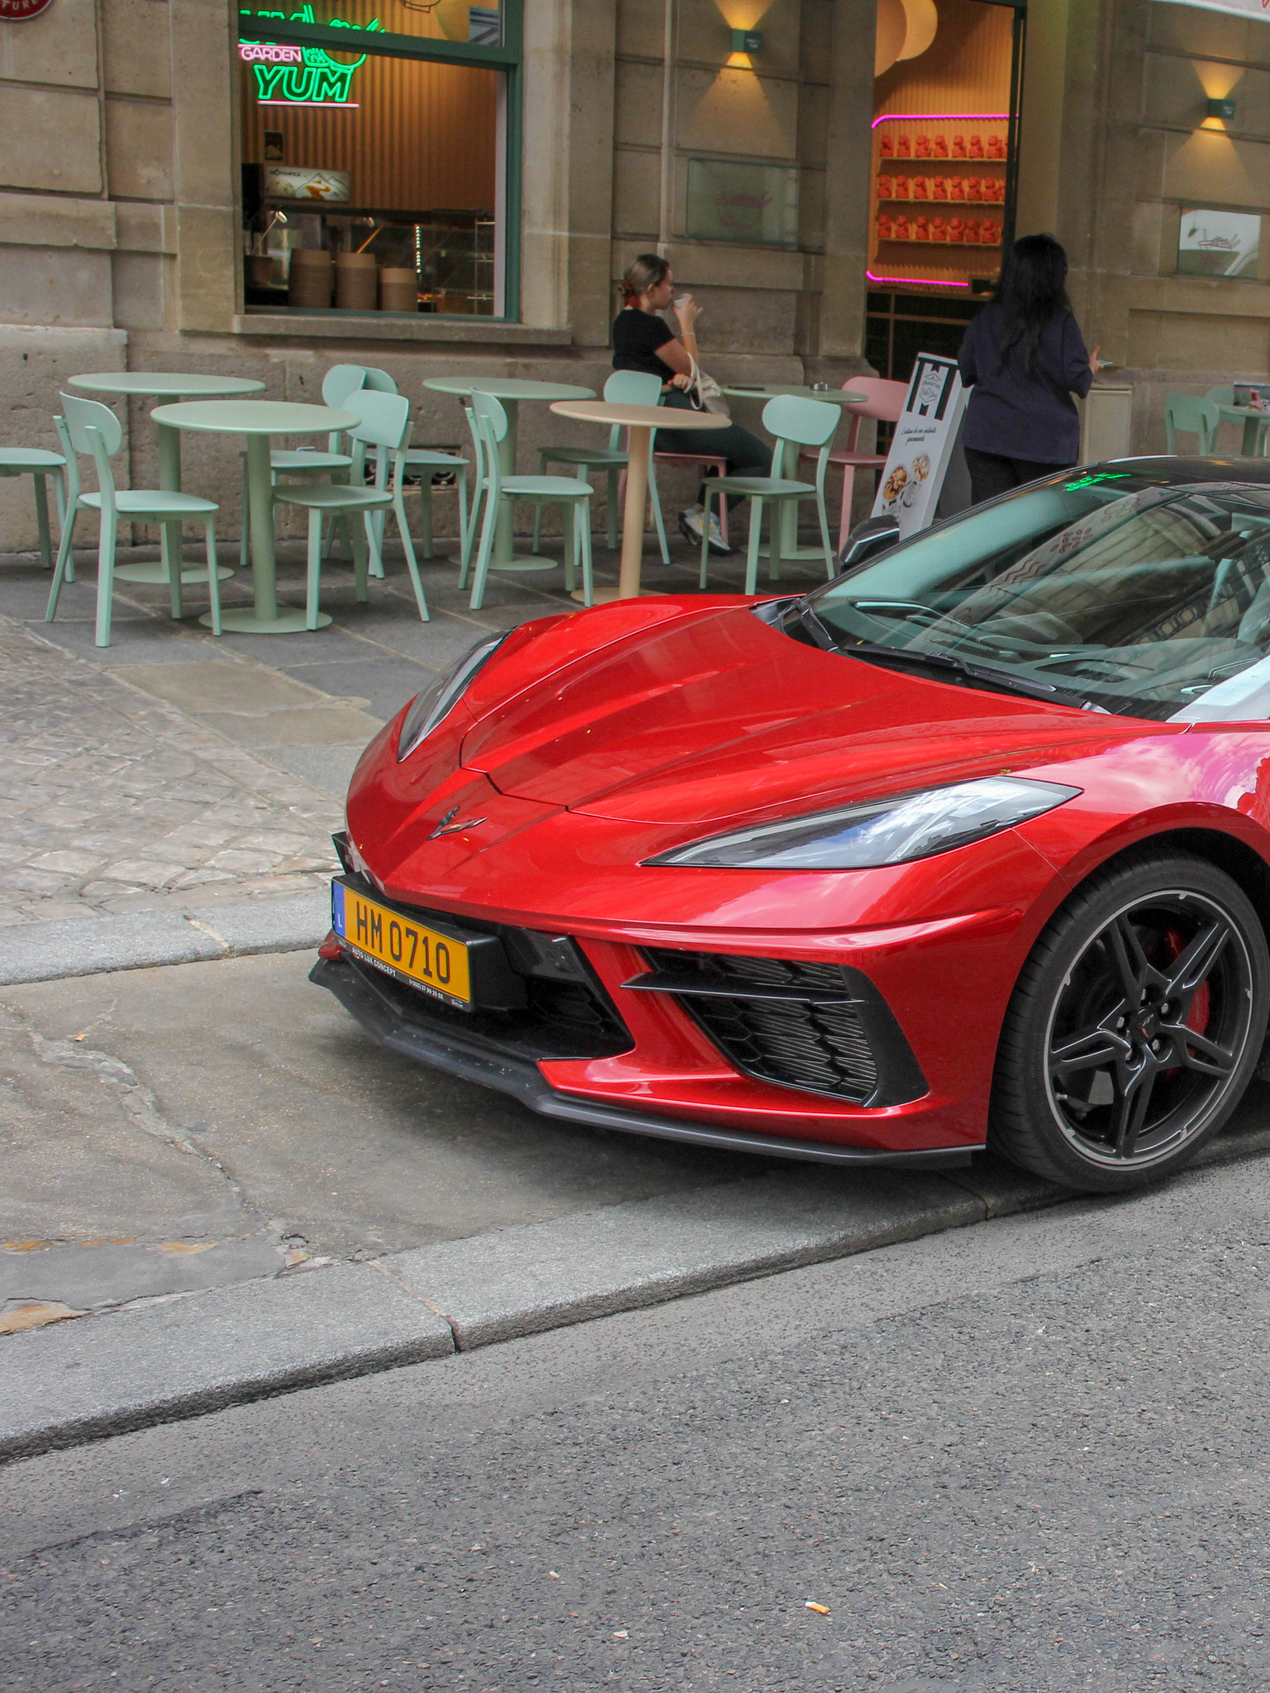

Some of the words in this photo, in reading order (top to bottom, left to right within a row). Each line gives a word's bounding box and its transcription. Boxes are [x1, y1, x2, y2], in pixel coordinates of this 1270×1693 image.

[240, 47, 302, 62] GARDEN
[253, 64, 353, 102] YUM
[337, 913, 343, 928] L
[356, 901, 383, 953] HM
[389, 920, 451, 984] 0710
[364, 954, 374, 965] LUX
[373, 959, 396, 977] CONCEPT
